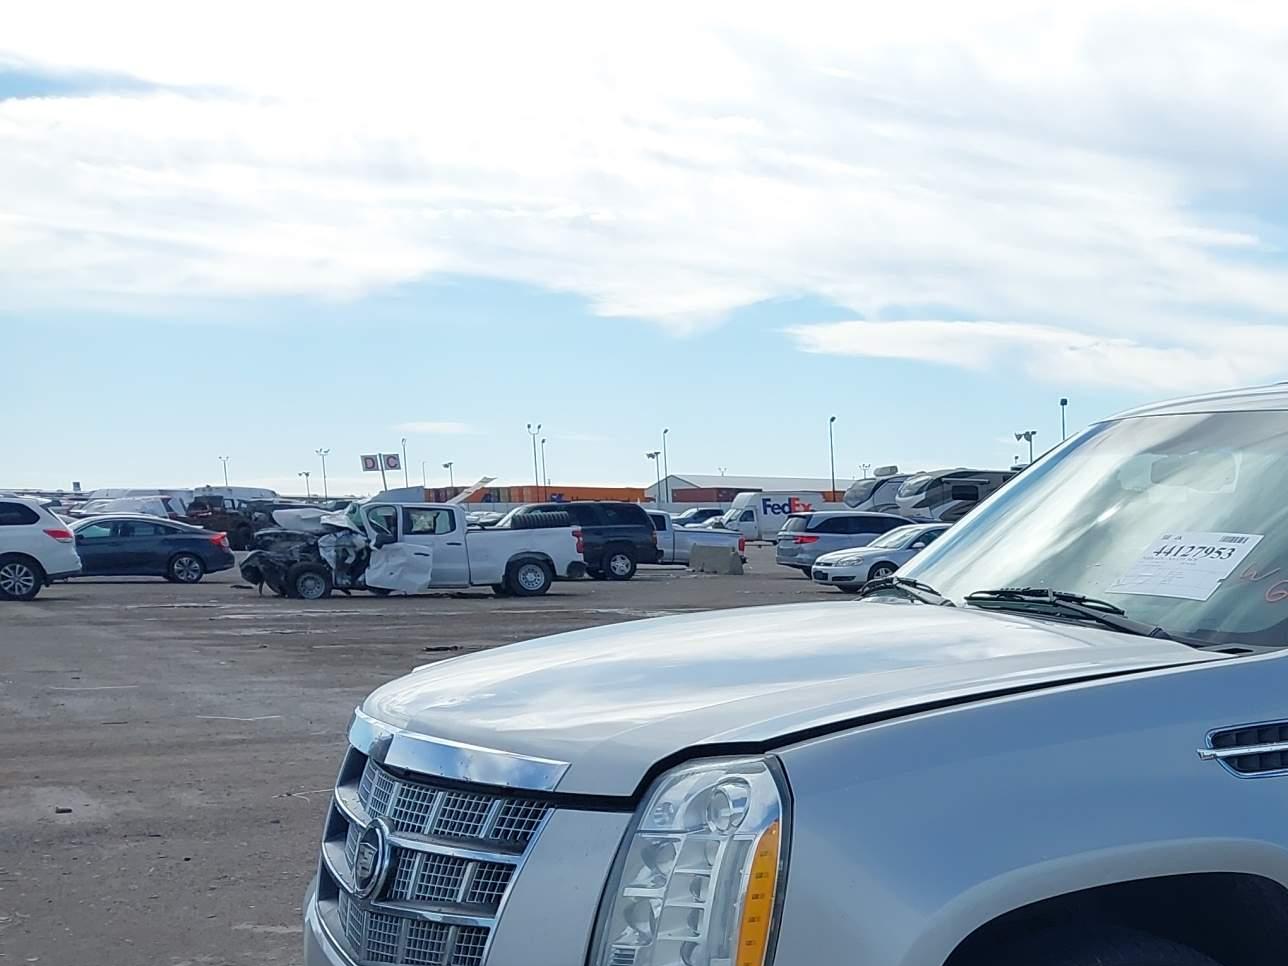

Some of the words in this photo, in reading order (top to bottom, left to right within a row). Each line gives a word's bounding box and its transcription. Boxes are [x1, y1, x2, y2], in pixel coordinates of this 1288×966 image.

[364, 456, 375, 469] D
[386, 455, 397, 468] C
[762, 496, 813, 515] FedEx
[1152, 545, 1236, 560] 44127953
